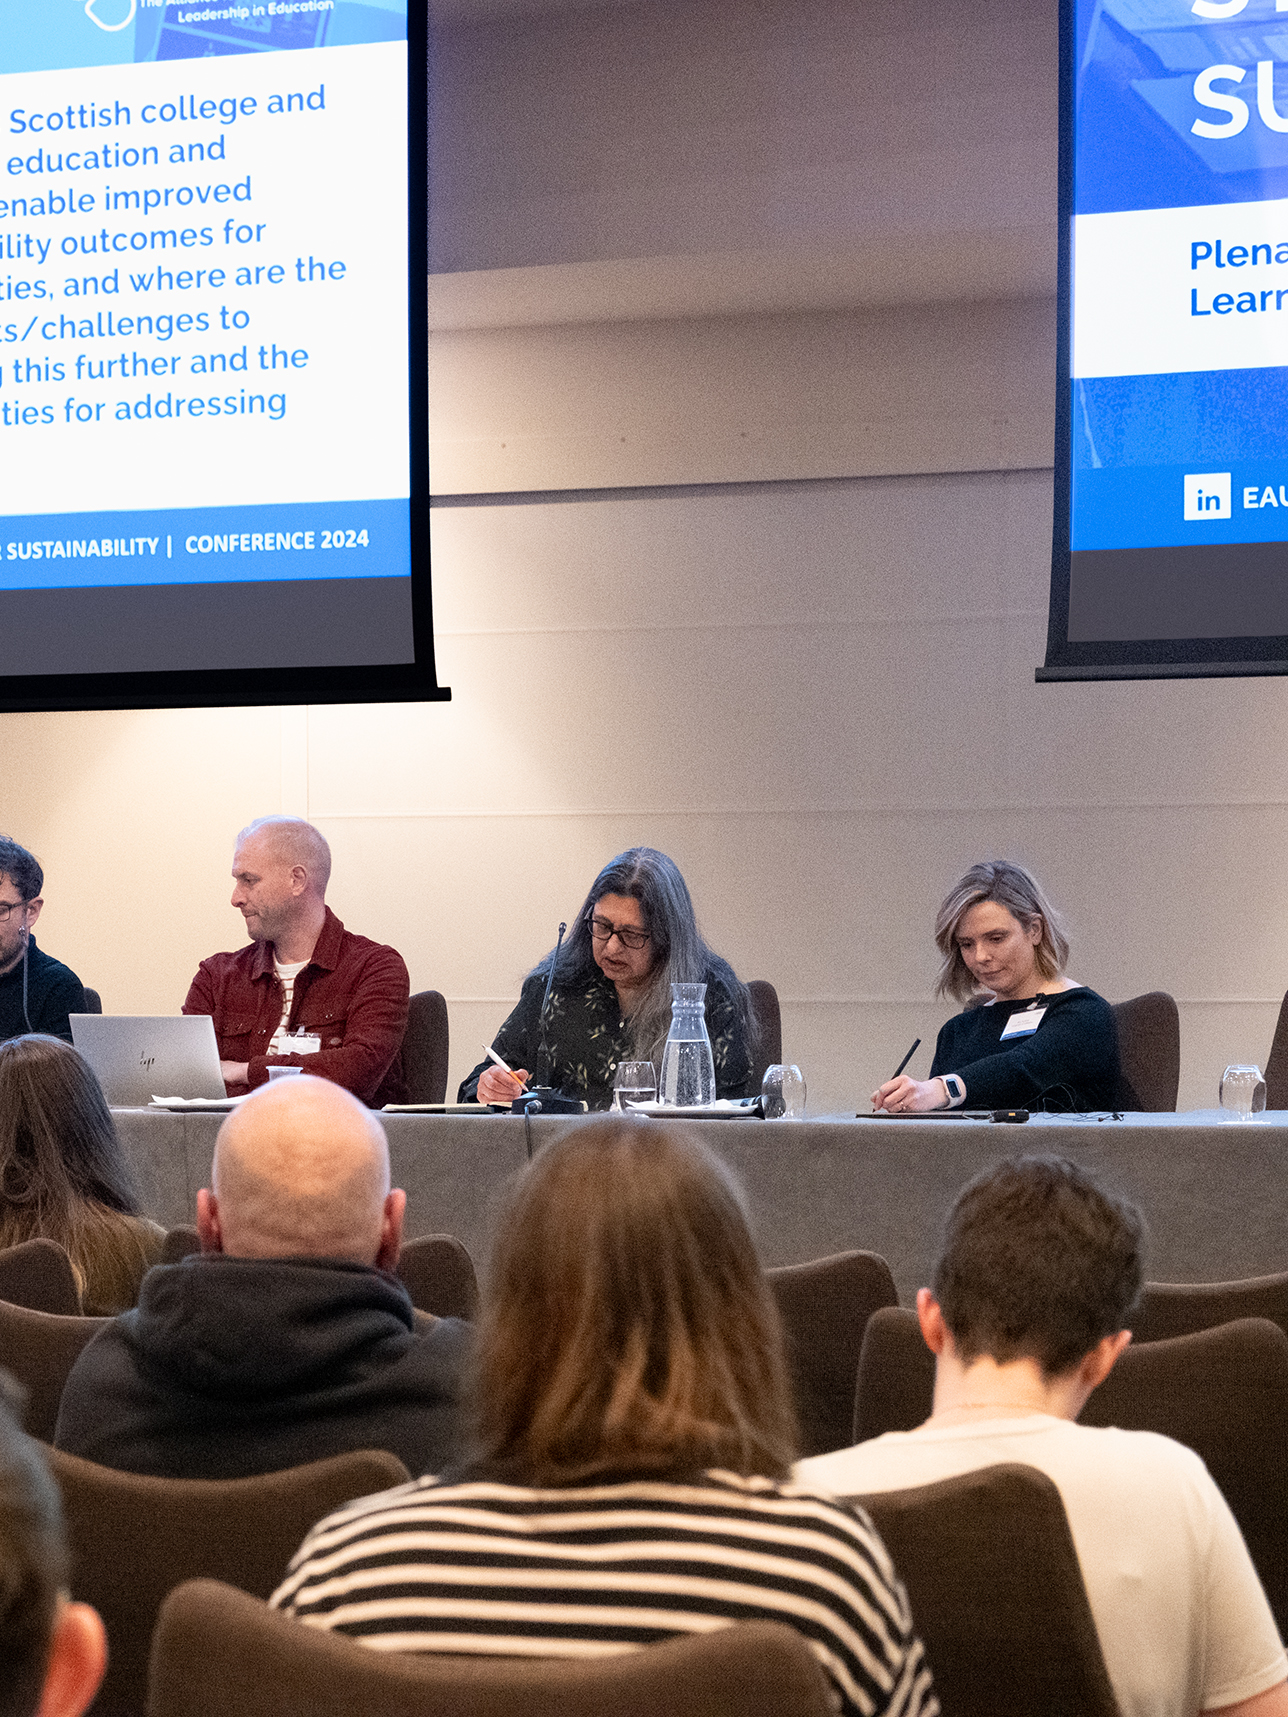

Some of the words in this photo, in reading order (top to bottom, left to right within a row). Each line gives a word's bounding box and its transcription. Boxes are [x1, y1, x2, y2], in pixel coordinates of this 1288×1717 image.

[178, 7, 249, 23] Leadership
[253, 3, 265, 16] in
[268, 0, 334, 15] Education
[10, 102, 130, 133] Scottish
[141, 95, 257, 124] college
[268, 84, 325, 113] and
[7, 143, 158, 175] education
[169, 134, 225, 163] and
[106, 175, 251, 215] improved
[61, 228, 213, 255] outcomes
[224, 219, 266, 244] for
[64, 269, 119, 296] and
[129, 266, 225, 292] where
[236, 265, 285, 286] are
[296, 256, 346, 282] the
[220, 306, 249, 329] to
[13, 357, 65, 383] this
[75, 352, 181, 379] further
[191, 346, 247, 373] and
[258, 344, 308, 369] the
[64, 397, 105, 422] for
[115, 389, 285, 420] addressing
[1198, 489, 1220, 511] in
[8, 538, 158, 559] SUSTAINABILITY
[186, 532, 314, 552] CONFERENCE
[322, 530, 369, 548] 2024
